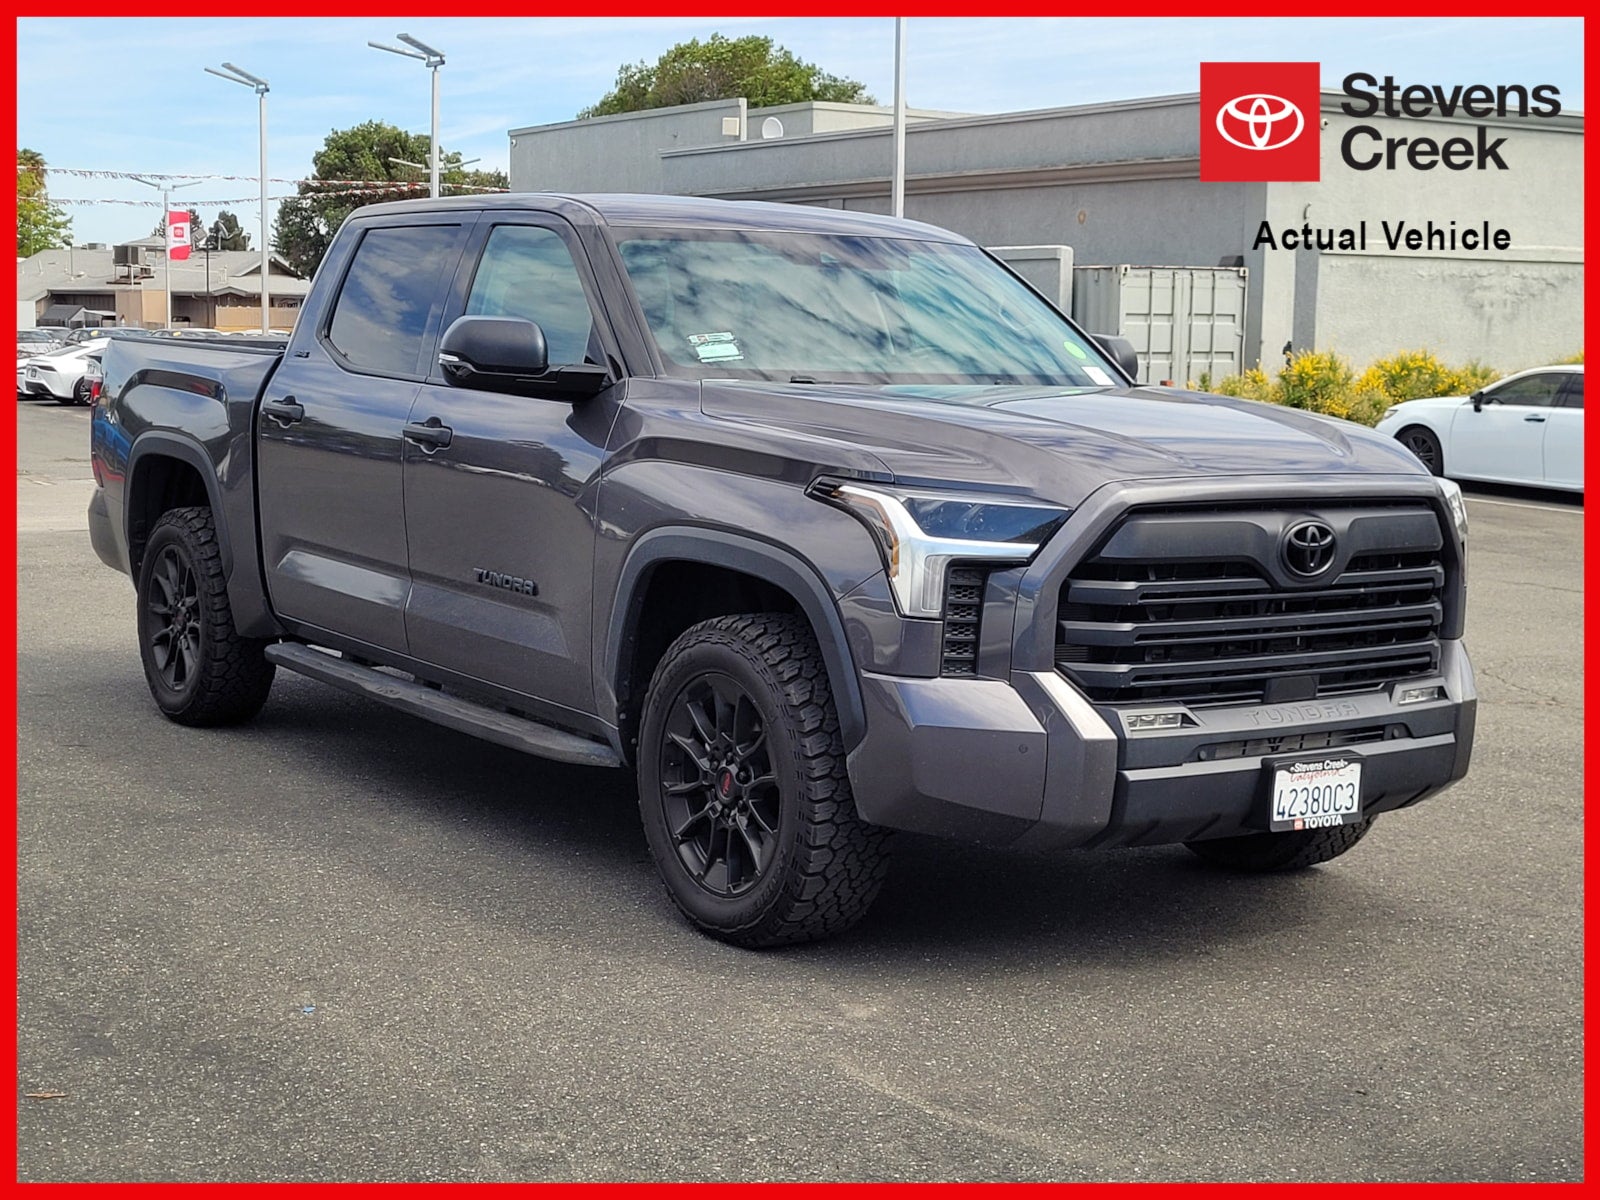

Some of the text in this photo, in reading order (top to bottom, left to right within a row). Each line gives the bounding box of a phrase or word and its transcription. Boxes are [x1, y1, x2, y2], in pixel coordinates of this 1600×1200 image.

[473, 567, 539, 597] TUNDRA
[1244, 703, 1360, 726] TUNDRA
[1276, 782, 1356, 819] 42380C3
[1303, 815, 1344, 829] TOYOTA
